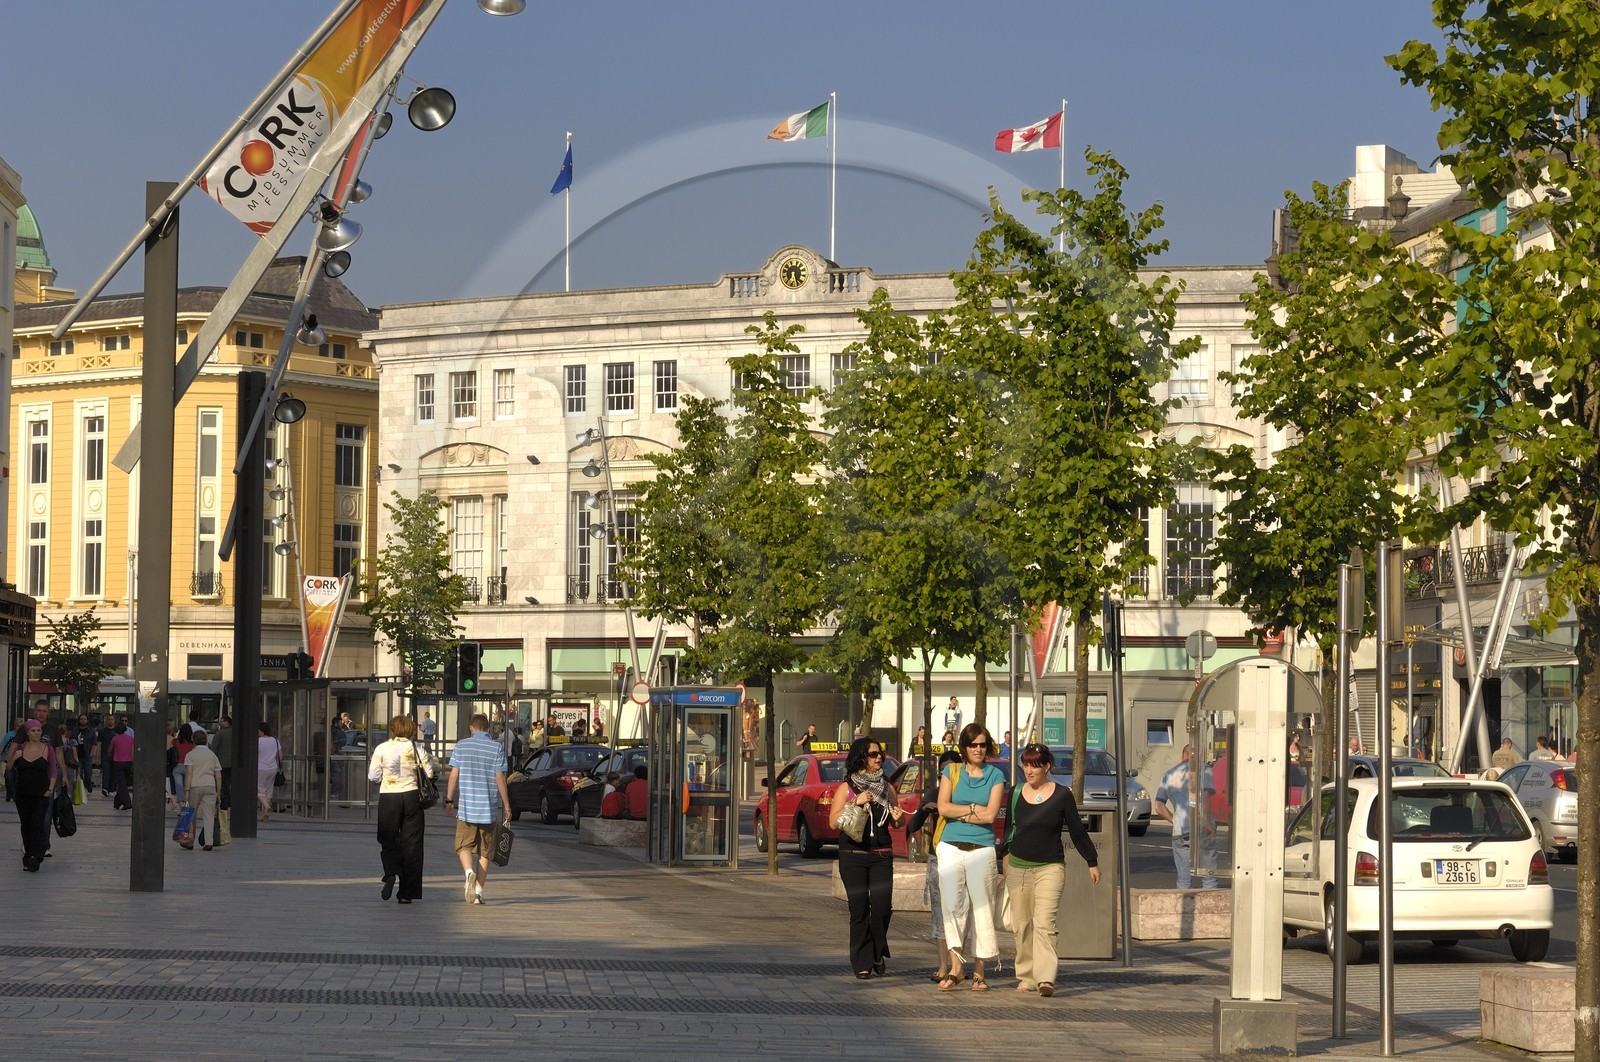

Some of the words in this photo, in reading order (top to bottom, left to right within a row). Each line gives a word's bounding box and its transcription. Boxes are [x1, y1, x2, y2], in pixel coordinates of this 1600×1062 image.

[336, 0, 401, 75] www.corkfestiv
[223, 87, 316, 199] CORK
[247, 111, 325, 211] MIDSUMMER
[264, 131, 323, 207] FESTIVAL
[306, 578, 337, 590] CORK
[698, 694, 726, 703] eircom
[553, 710, 577, 720] Serves
[1446, 861, 1472, 872] 98-C
[1445, 872, 1476, 882] 23616
